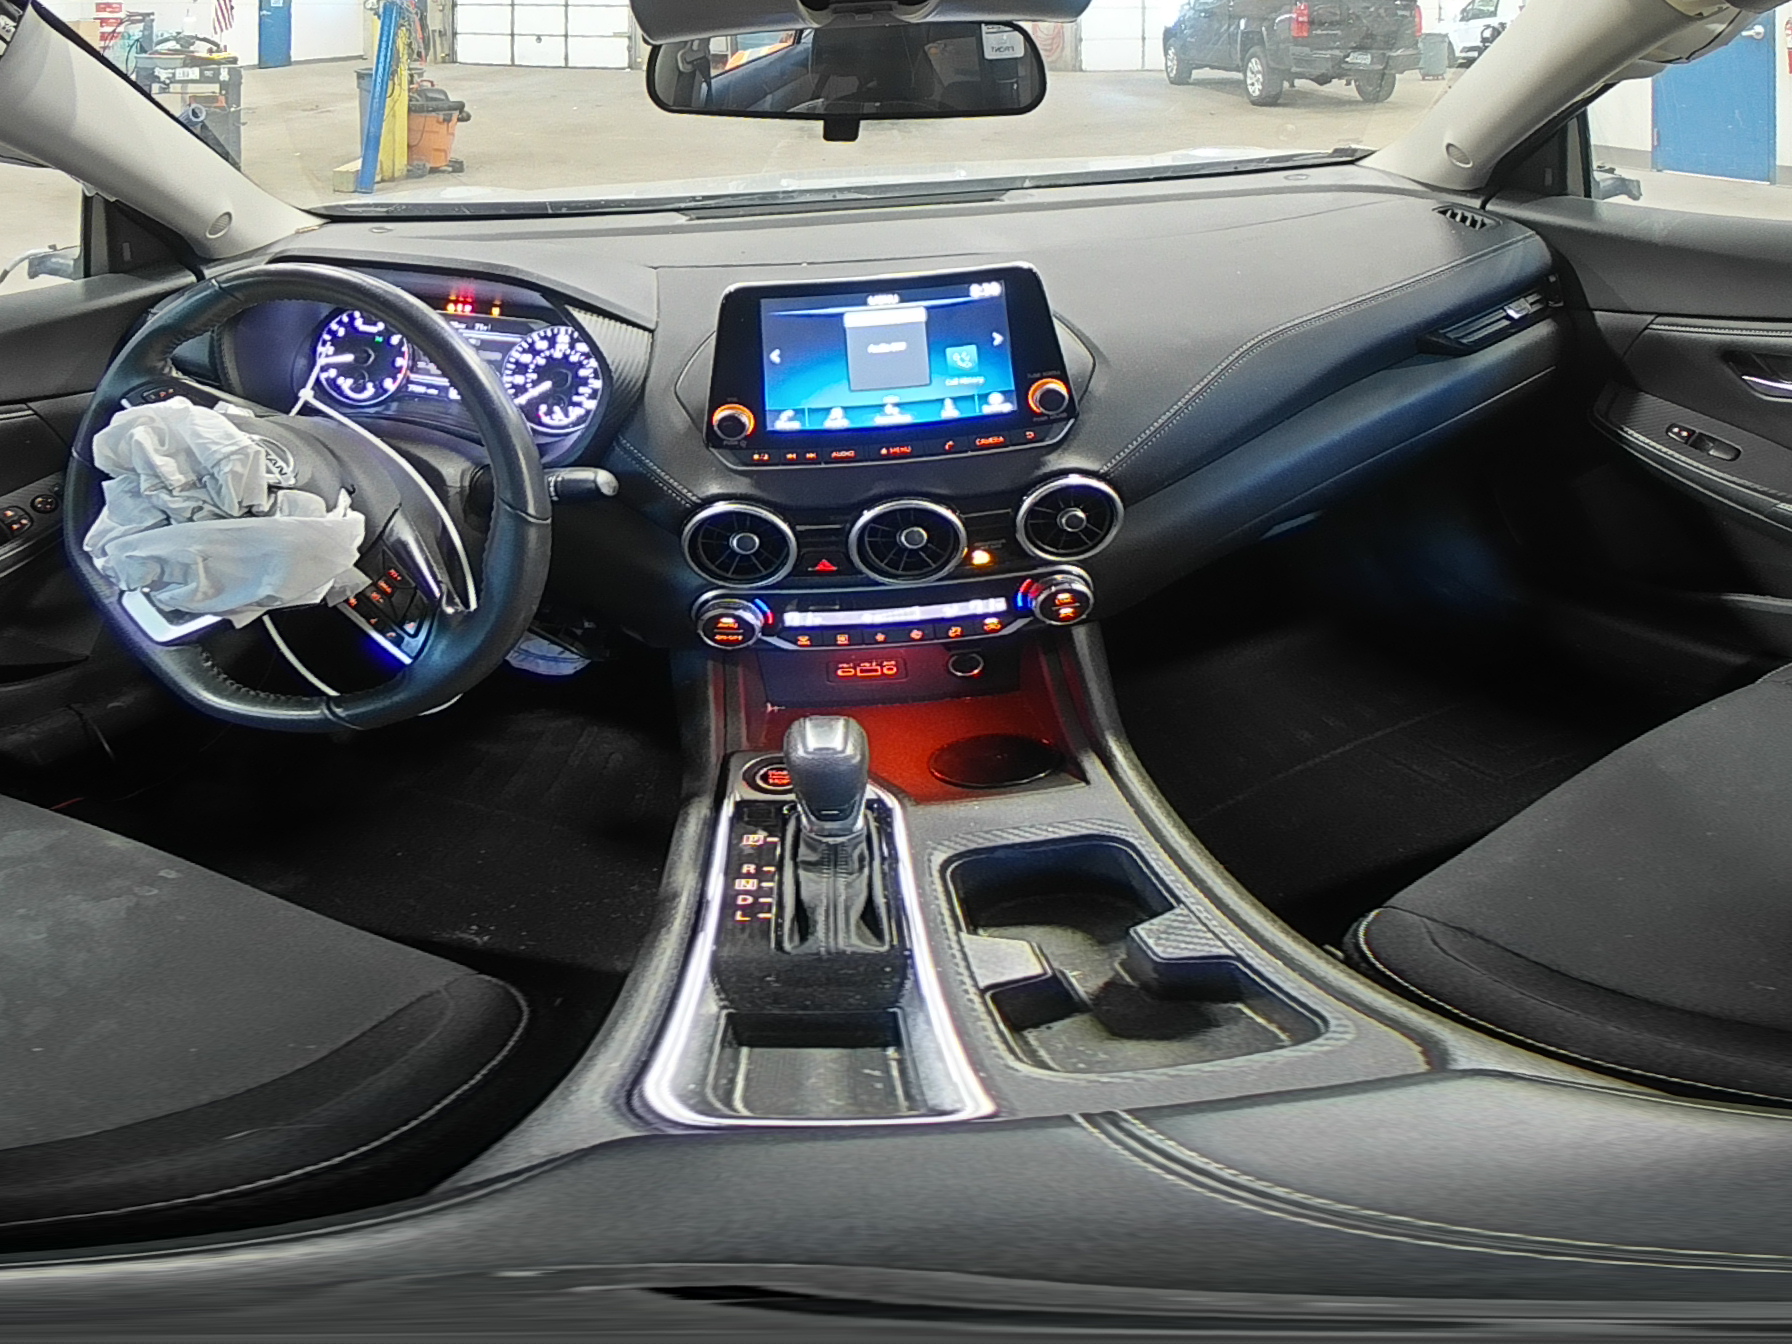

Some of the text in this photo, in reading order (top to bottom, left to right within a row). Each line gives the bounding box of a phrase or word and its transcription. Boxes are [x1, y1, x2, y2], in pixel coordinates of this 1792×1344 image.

[975, 435, 1005, 445] CAMERA
[831, 450, 856, 458] AUDIO
[742, 864, 757, 874] R
[736, 895, 754, 905] D
[735, 911, 751, 921] L
